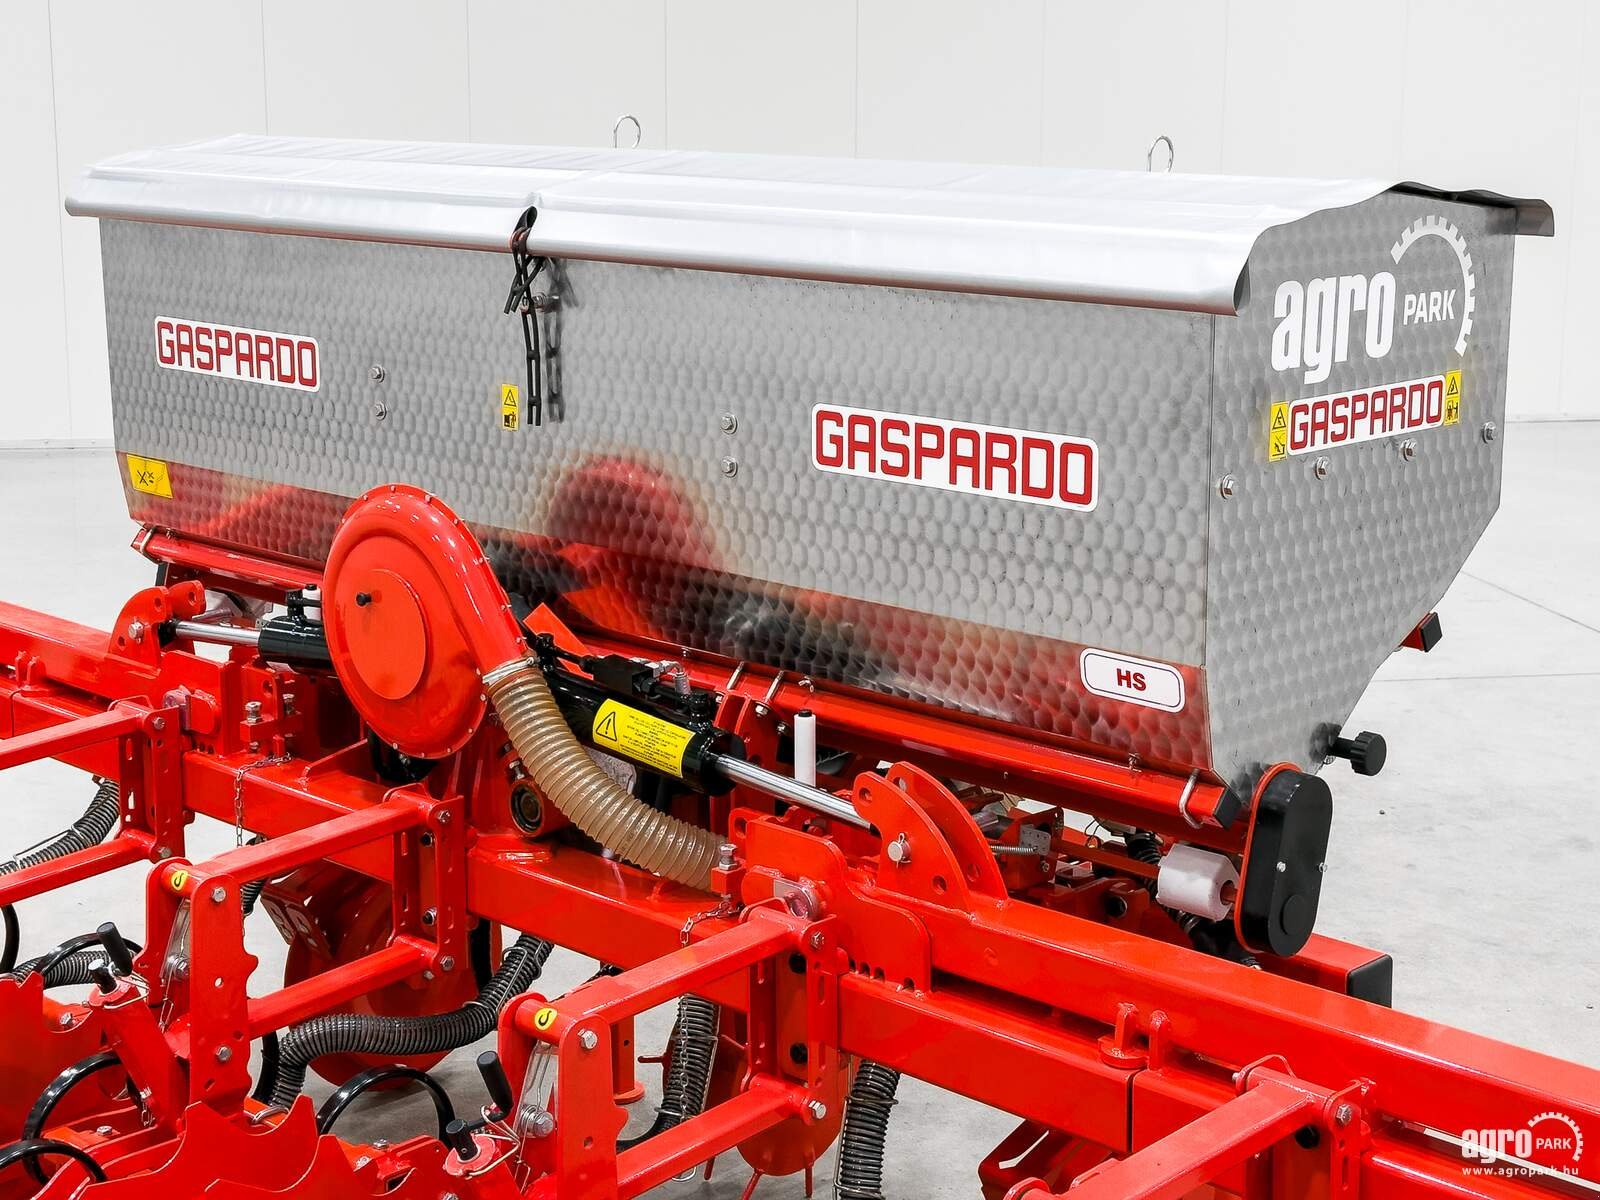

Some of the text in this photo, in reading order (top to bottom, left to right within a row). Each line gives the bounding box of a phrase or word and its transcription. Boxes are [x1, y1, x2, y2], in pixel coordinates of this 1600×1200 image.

[157, 321, 317, 387] GASPARDO
[1271, 271, 1457, 385] agro PARK
[1290, 380, 1443, 450] GASPARDO
[816, 410, 1093, 505] GASPARDO
[1116, 668, 1147, 691] HS
